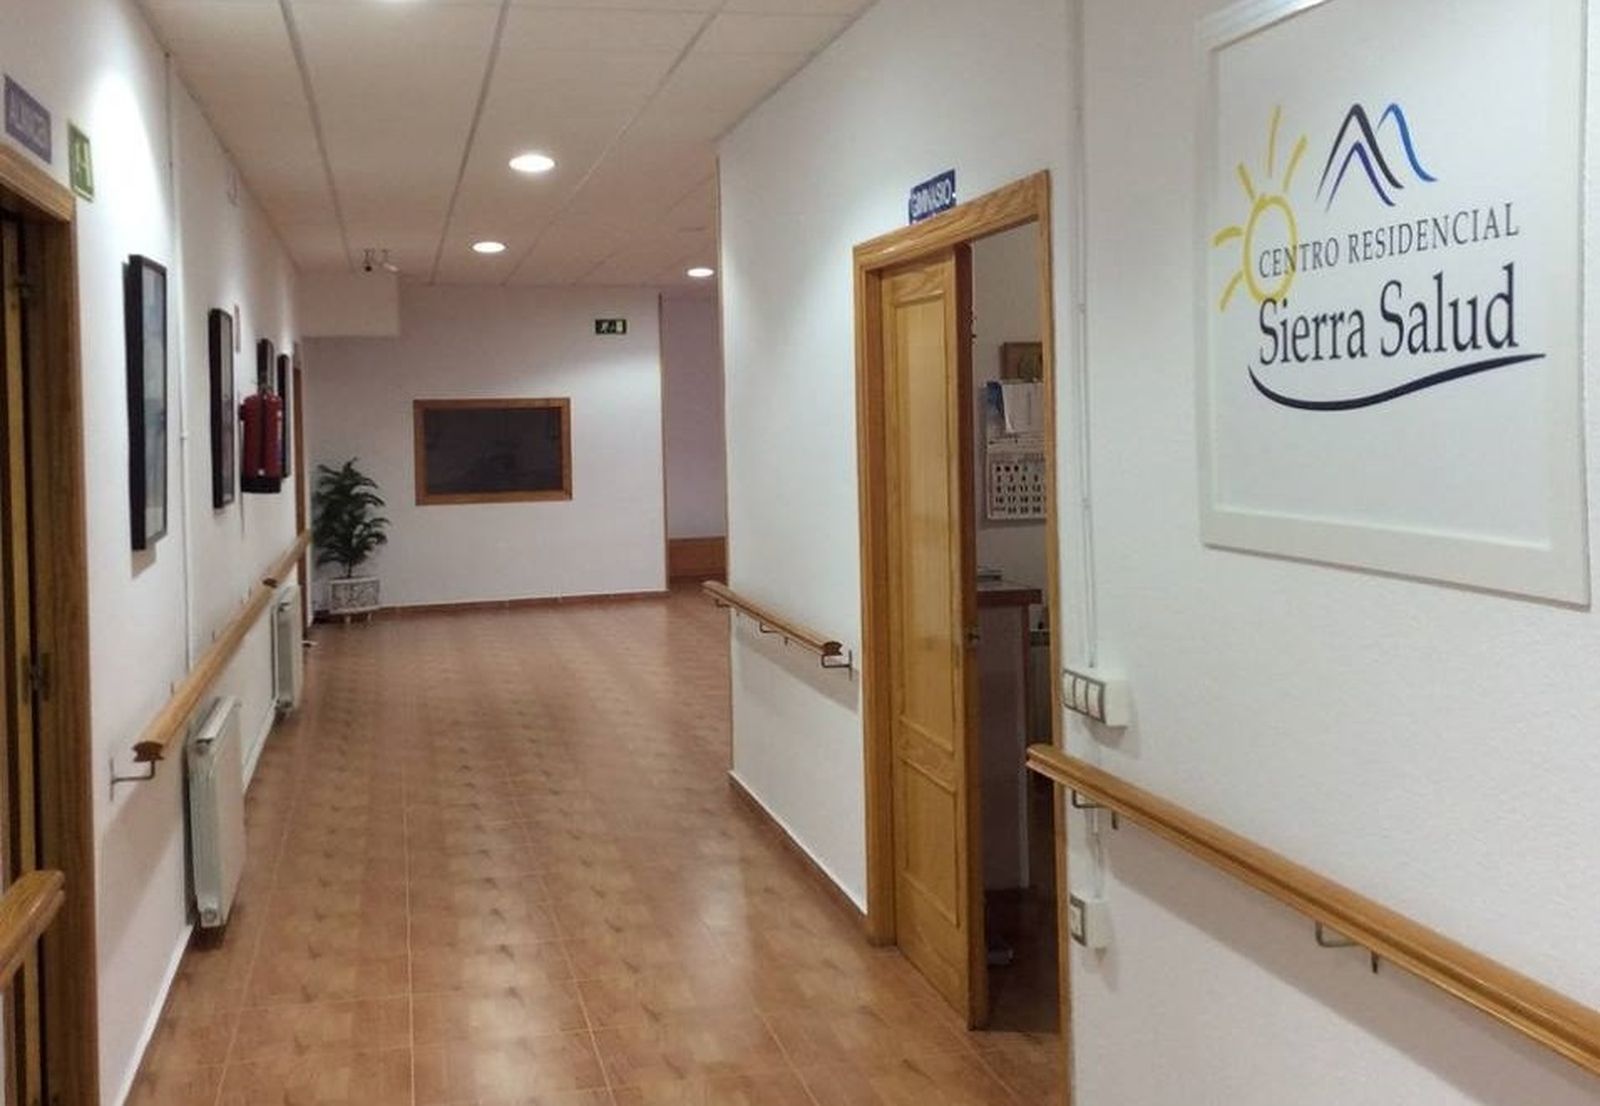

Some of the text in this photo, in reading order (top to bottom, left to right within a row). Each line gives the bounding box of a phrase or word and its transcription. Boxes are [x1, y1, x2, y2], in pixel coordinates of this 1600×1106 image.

[1258, 202, 1520, 279] CENTRO RESIDENCIAL
[1258, 261, 1520, 366] Sierra Salud
